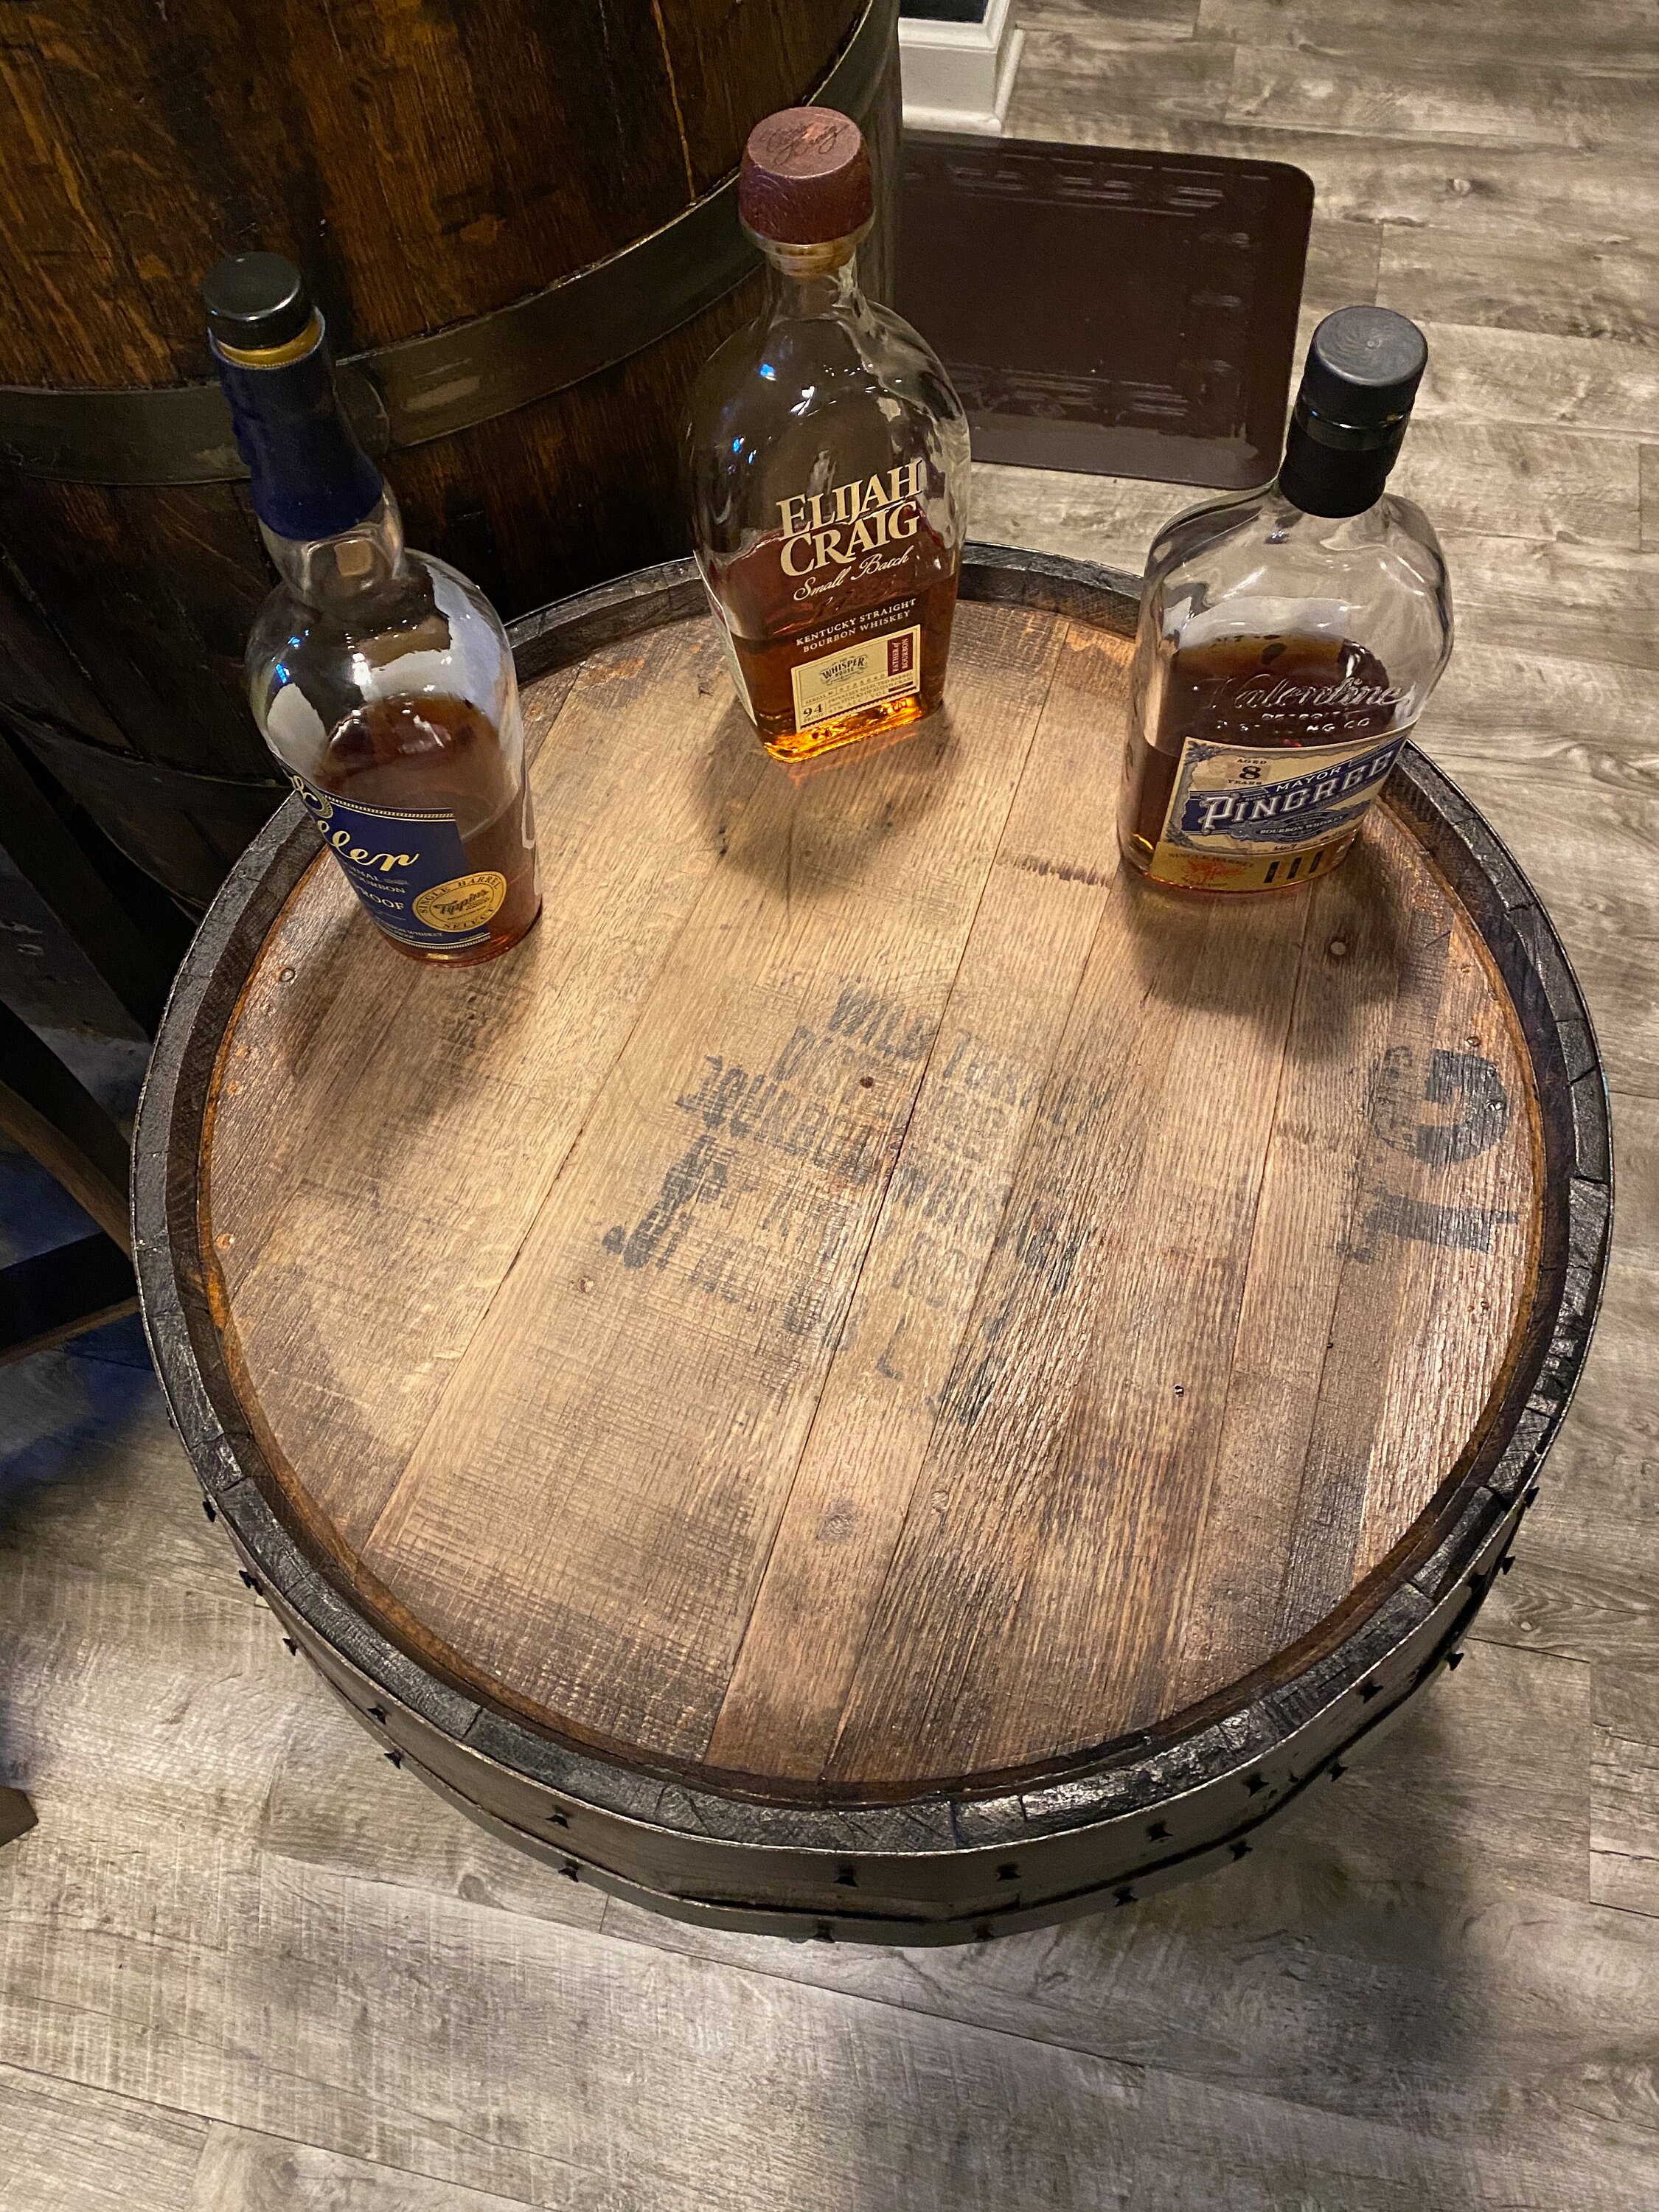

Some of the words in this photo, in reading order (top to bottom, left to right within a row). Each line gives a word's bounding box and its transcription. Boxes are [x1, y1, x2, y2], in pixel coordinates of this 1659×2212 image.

[776, 458, 923, 540] ELIJAH
[780, 501, 919, 577] CRAIG
[793, 566, 852, 601] Small
[851, 546, 914, 580] Batch
[796, 617, 856, 646] KENTUCKY
[860, 599, 917, 622] STRAIGHT
[804, 627, 856, 653] BOURBON
[860, 610, 911, 631] WHISKEY
[821, 657, 865, 679] WHISPER
[901, 638, 909, 669] BOURBON
[835, 667, 855, 678] HOUSE
[806, 694, 826, 703] SERIAL
[1192, 673, 1415, 709] Valentine
[803, 703, 824, 718] 94
[804, 713, 824, 723] PROOF
[1239, 765, 1262, 780] 8
[1276, 765, 1342, 792] MAYOR
[1197, 750, 1394, 831] PINGREE
[1259, 825, 1303, 835] BOURBON
[1306, 815, 1343, 830] WHISKEY
[419, 886, 451, 914] SINGLE
[458, 876, 502, 890] BARREL
